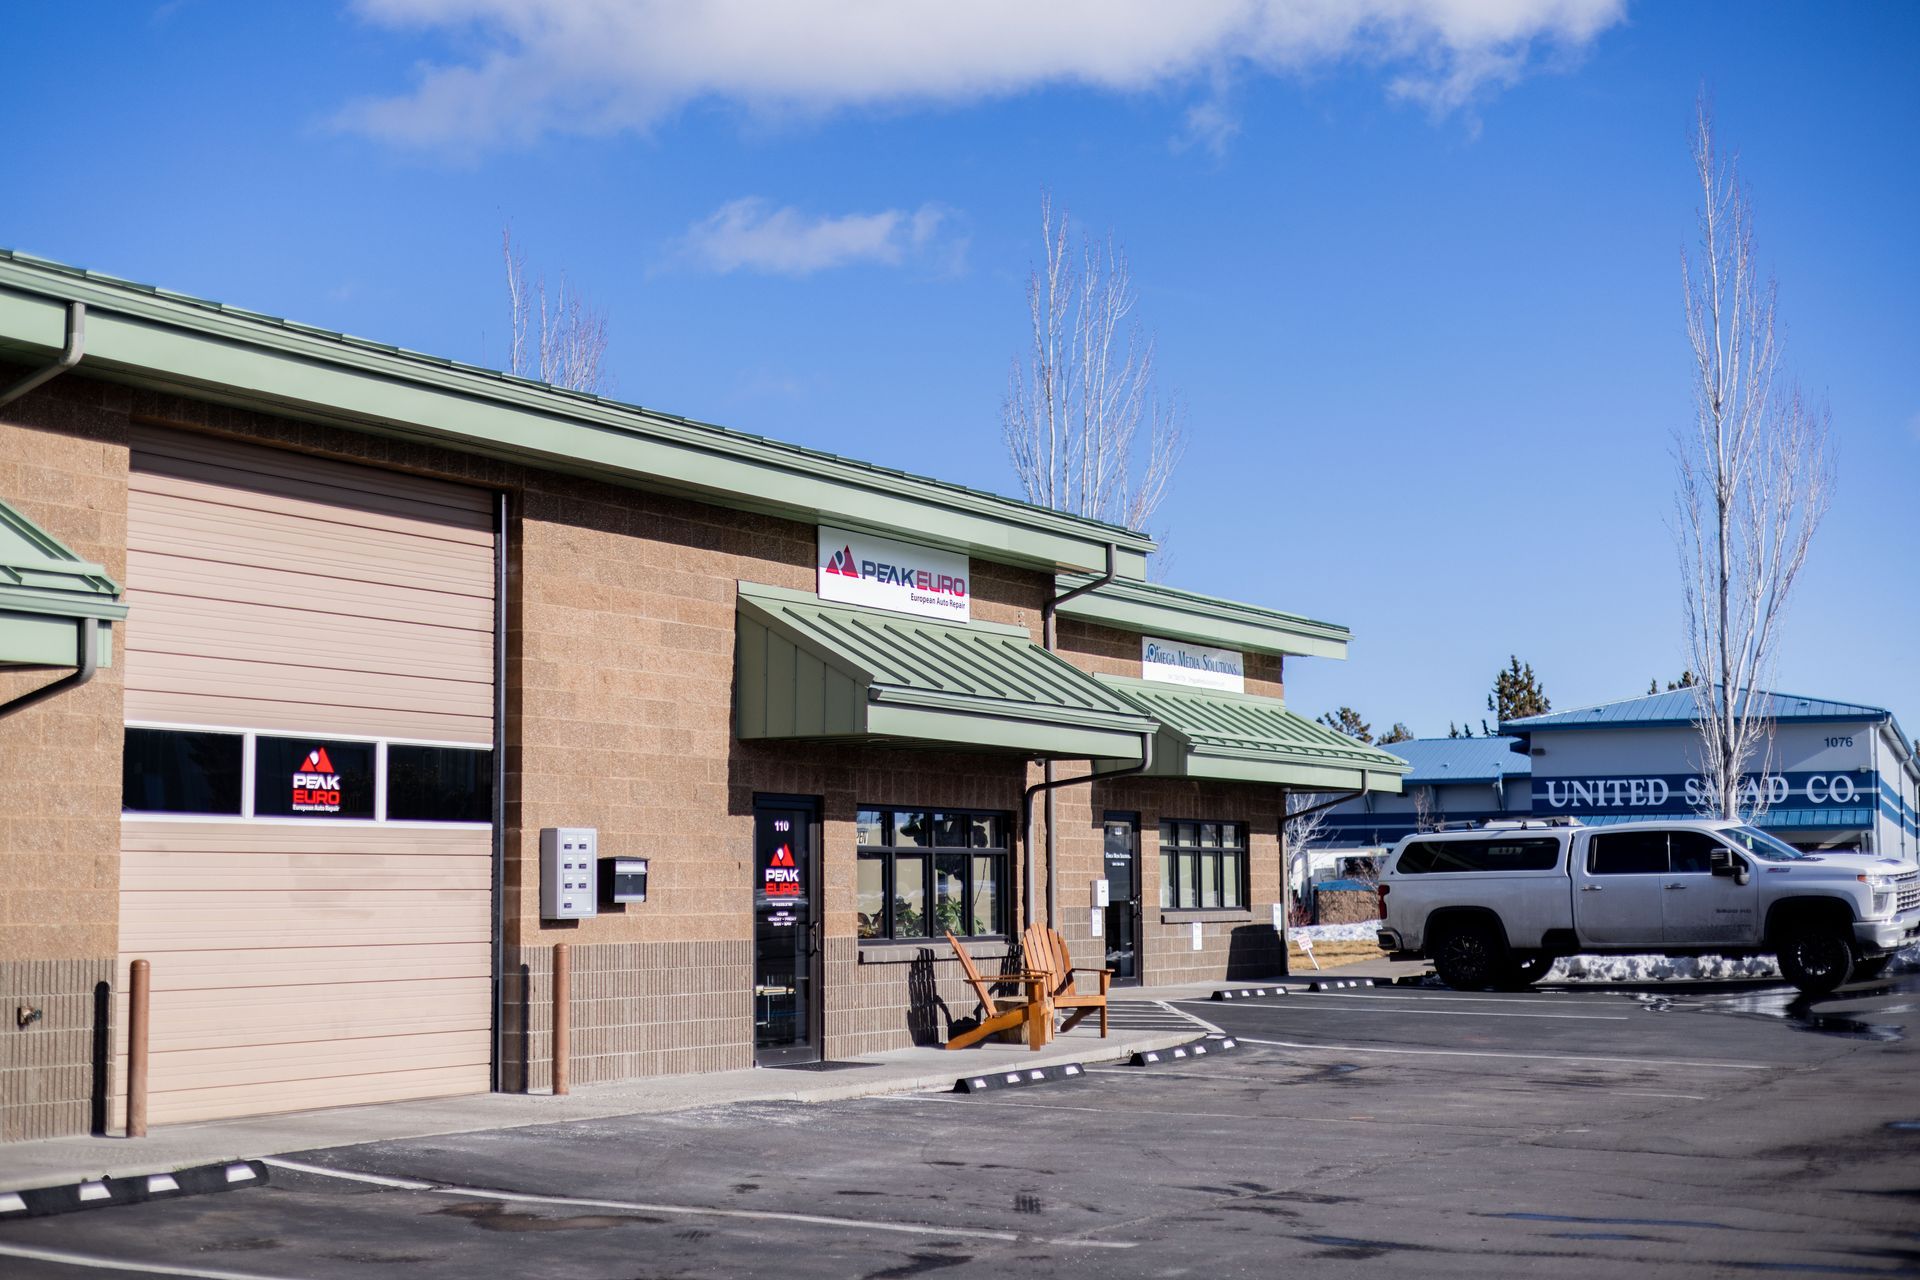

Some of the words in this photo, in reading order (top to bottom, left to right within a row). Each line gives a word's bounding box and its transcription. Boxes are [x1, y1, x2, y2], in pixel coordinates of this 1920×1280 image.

[911, 593, 935, 604] European
[937, 597, 948, 606] Auto
[950, 600, 965, 610] Repair
[1824, 736, 1853, 748] 1076
[293, 773, 340, 790] PEAK
[293, 790, 340, 805] EURO
[1546, 777, 1669, 808] UNITED
[1684, 776, 1789, 806] SAAD
[1806, 775, 1861, 804] CO.
[774, 821, 789, 831] 110
[765, 869, 799, 882] PEAK
[765, 883, 799, 895] EURO
